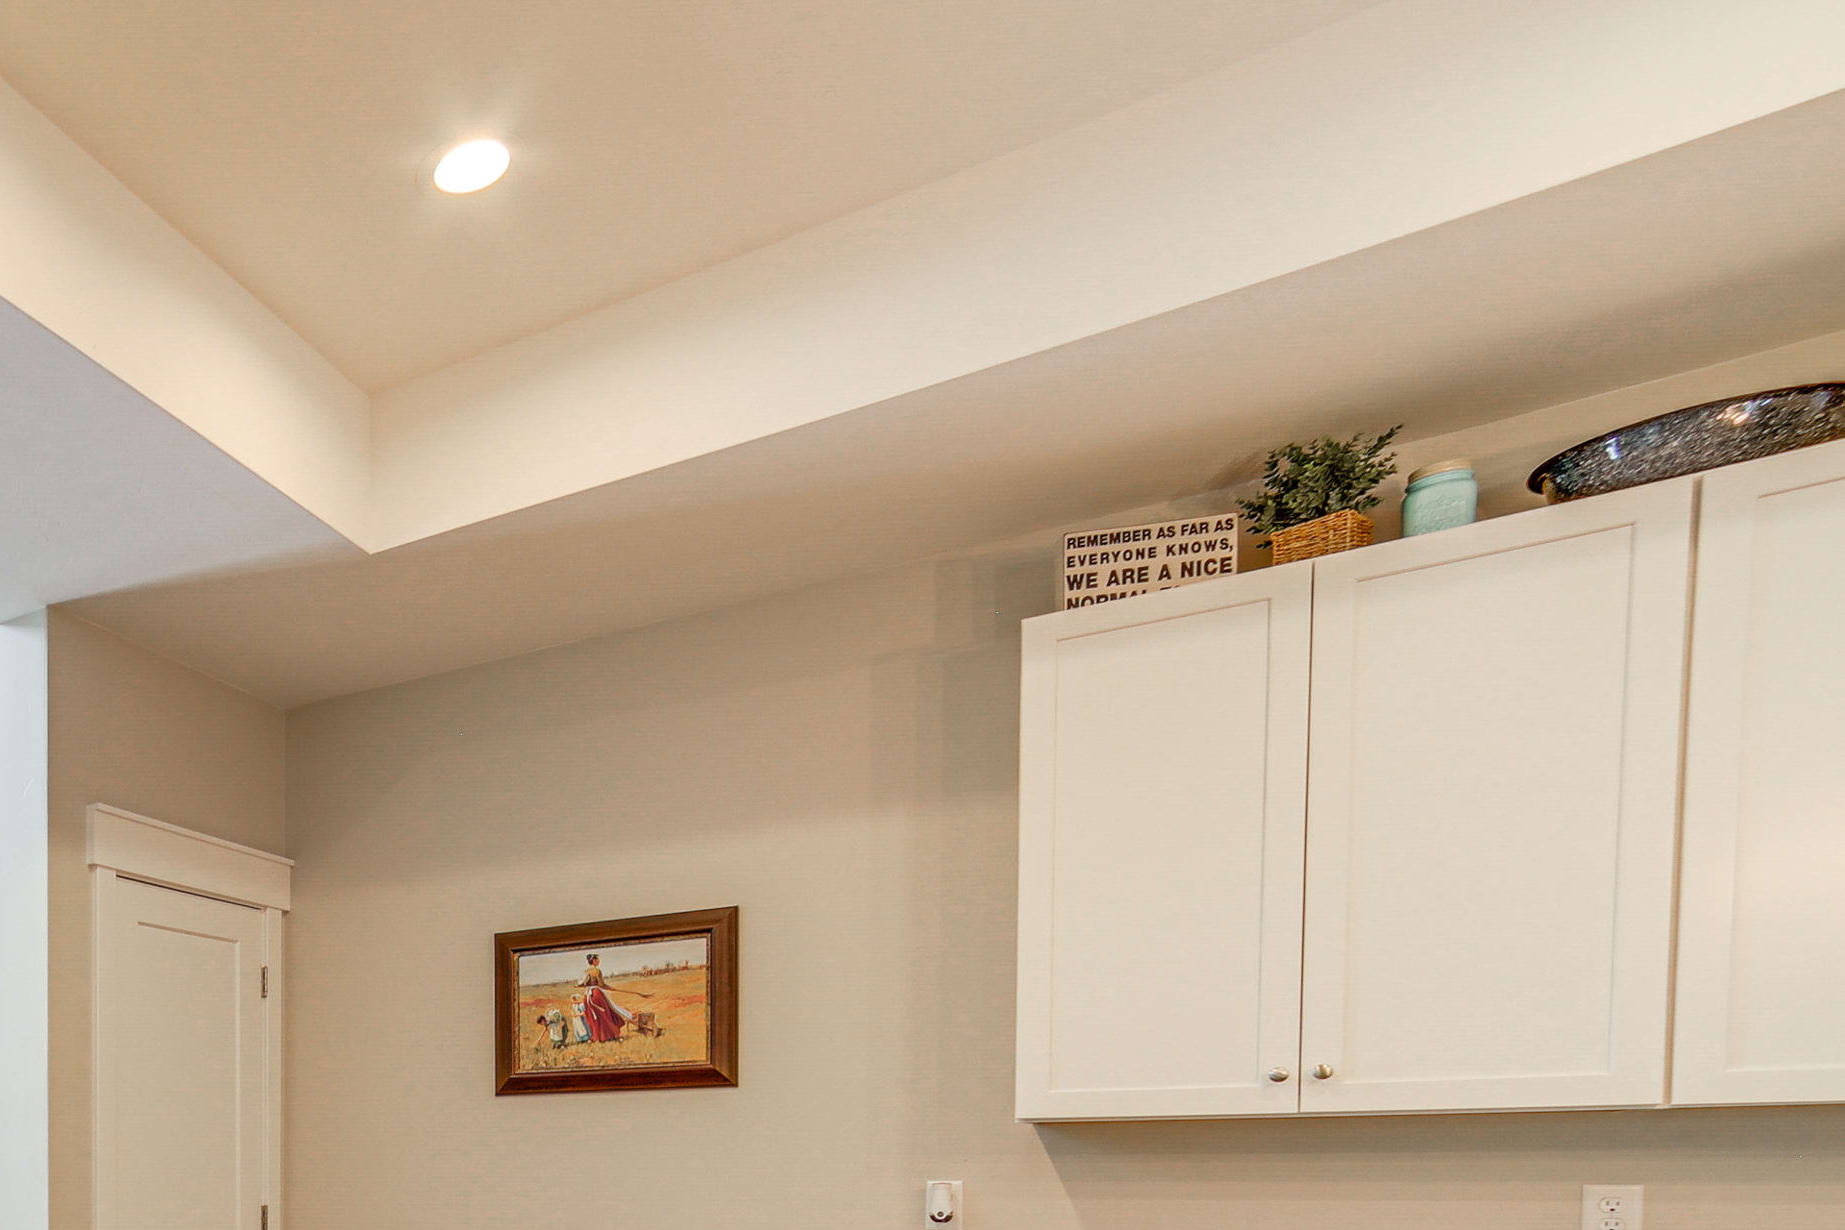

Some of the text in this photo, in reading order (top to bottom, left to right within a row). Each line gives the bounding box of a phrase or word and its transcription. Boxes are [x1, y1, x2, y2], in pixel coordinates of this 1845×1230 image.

[1066, 517, 1235, 550] REMEMBER AS FAR AS
[1066, 537, 1234, 569] EVERYONE KNOWS,
[1066, 555, 1233, 592] WE ARE A NICE
